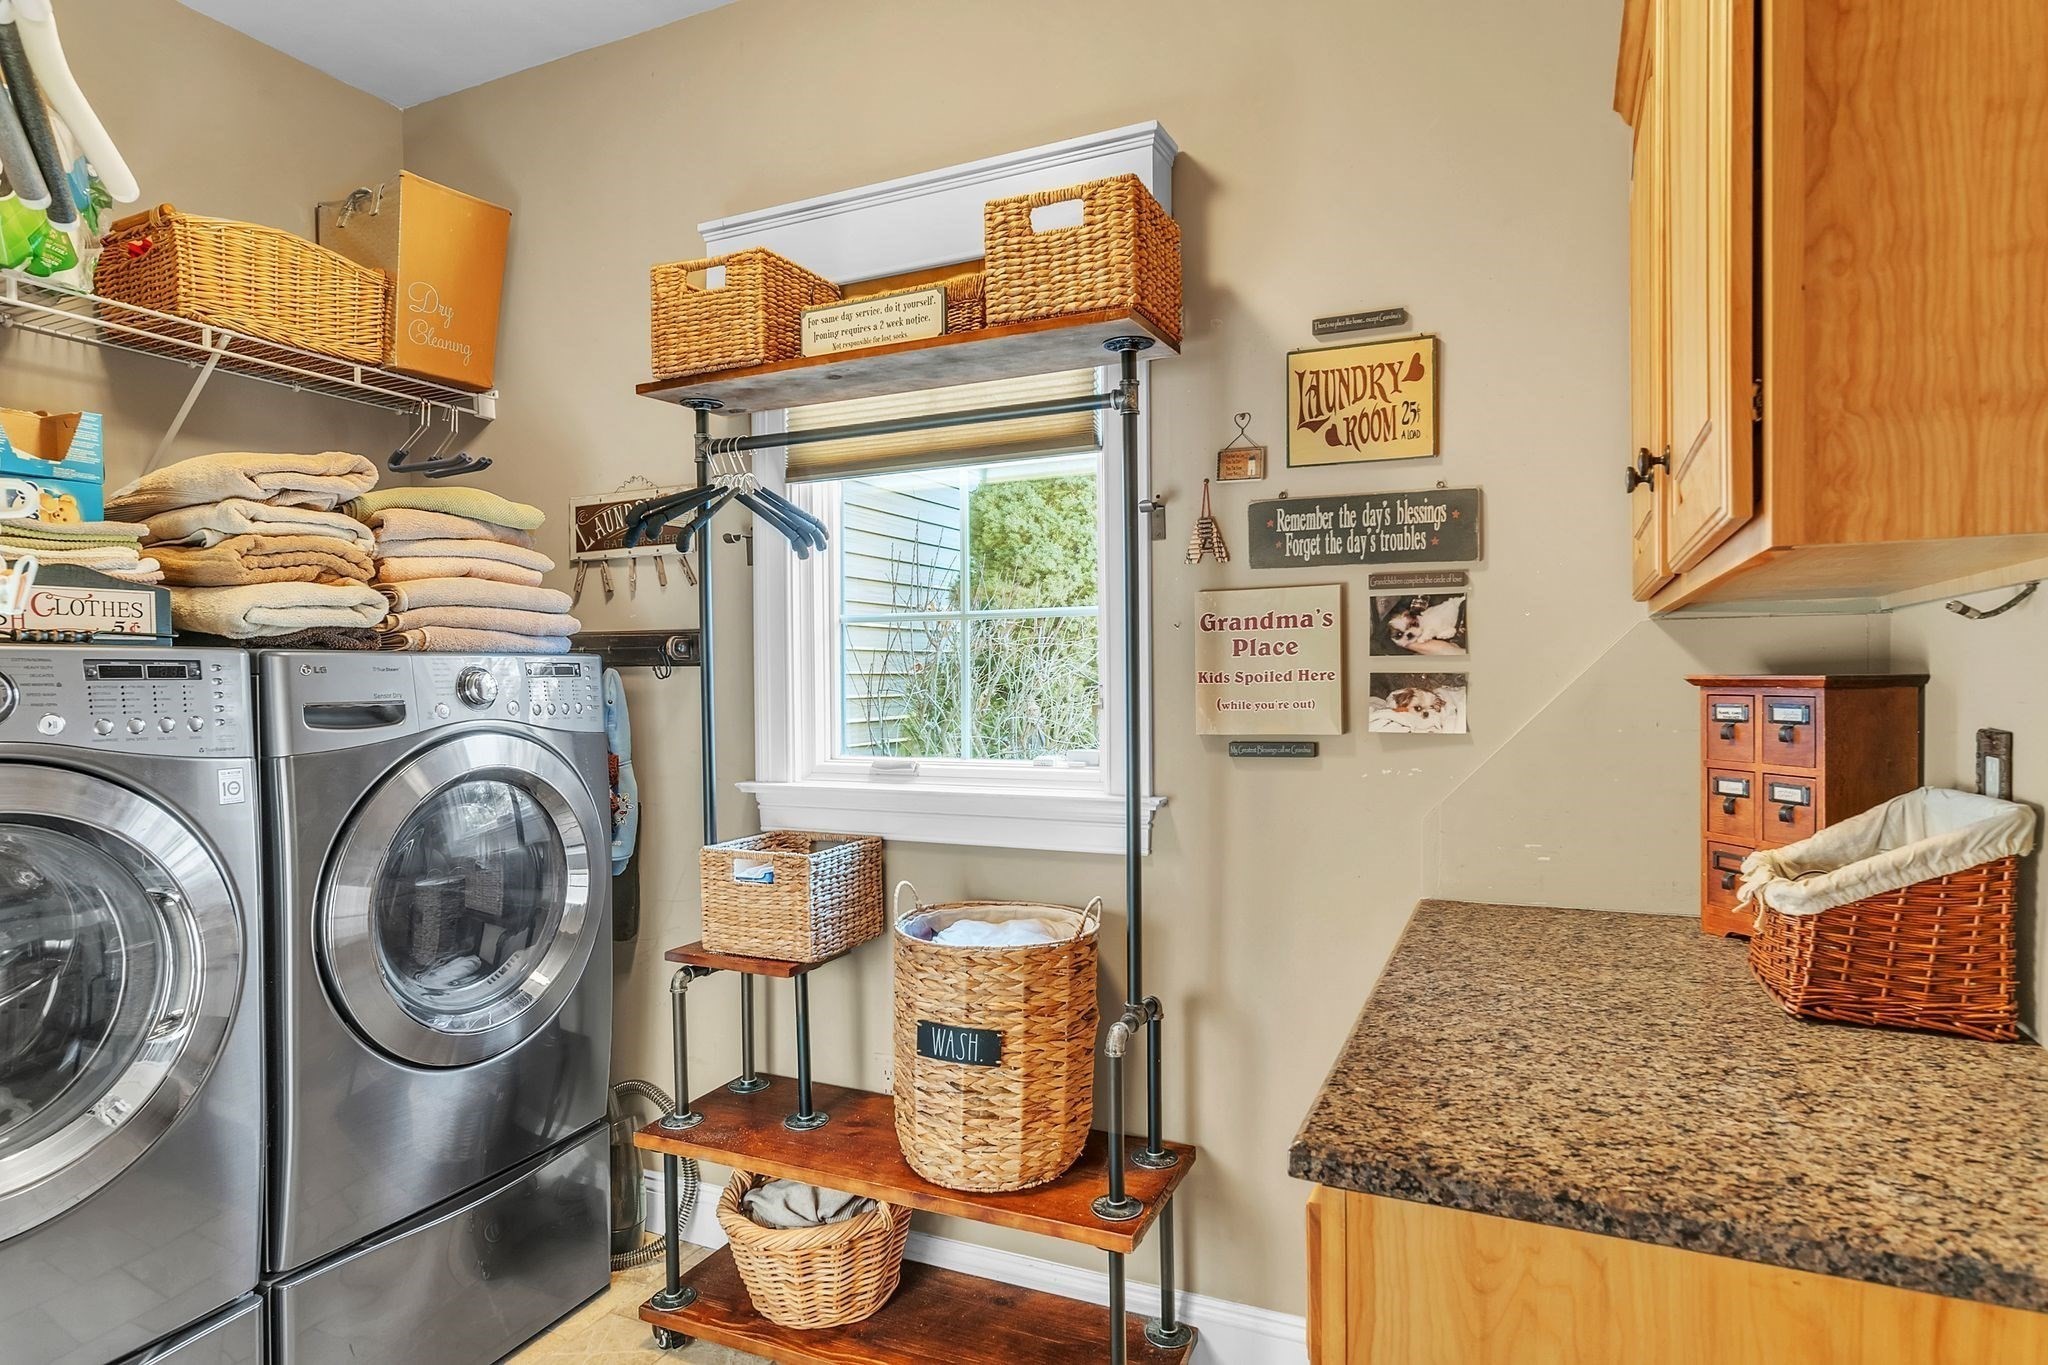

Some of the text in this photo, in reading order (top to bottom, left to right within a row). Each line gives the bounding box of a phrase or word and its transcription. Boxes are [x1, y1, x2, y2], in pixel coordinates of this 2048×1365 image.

[408, 281, 454, 328] Dry
[808, 317, 819, 329] For
[820, 314, 839, 326] same
[841, 311, 853, 322] day
[884, 303, 893, 313] do
[895, 302, 901, 312] it
[902, 295, 936, 312] yourself.
[408, 319, 472, 366] Cleaning
[813, 330, 839, 343] Ironing
[841, 324, 871, 337] requires
[880, 320, 885, 330] 2
[886, 317, 904, 328] week
[832, 342, 842, 351] Not
[842, 337, 872, 350] responsible
[872, 335, 880, 343] for
[881, 333, 892, 342] lost
[1294, 360, 1404, 433] LAUNDRY
[1343, 402, 1398, 452] ROOM
[1401, 429, 1421, 440] A LOAD
[1276, 497, 1447, 533] Remember the day's blessings
[1285, 525, 1427, 561] Forget the day's troubles
[30, 591, 144, 618] CLOTHES
[1200, 608, 1333, 632] Grandma's
[1232, 638, 1298, 657] Place
[313, 666, 327, 674] LG
[1198, 669, 1335, 686] Kids Spoiled Here
[1217, 698, 1315, 711] (while you're out)
[932, 1027, 983, 1062] WASH.
